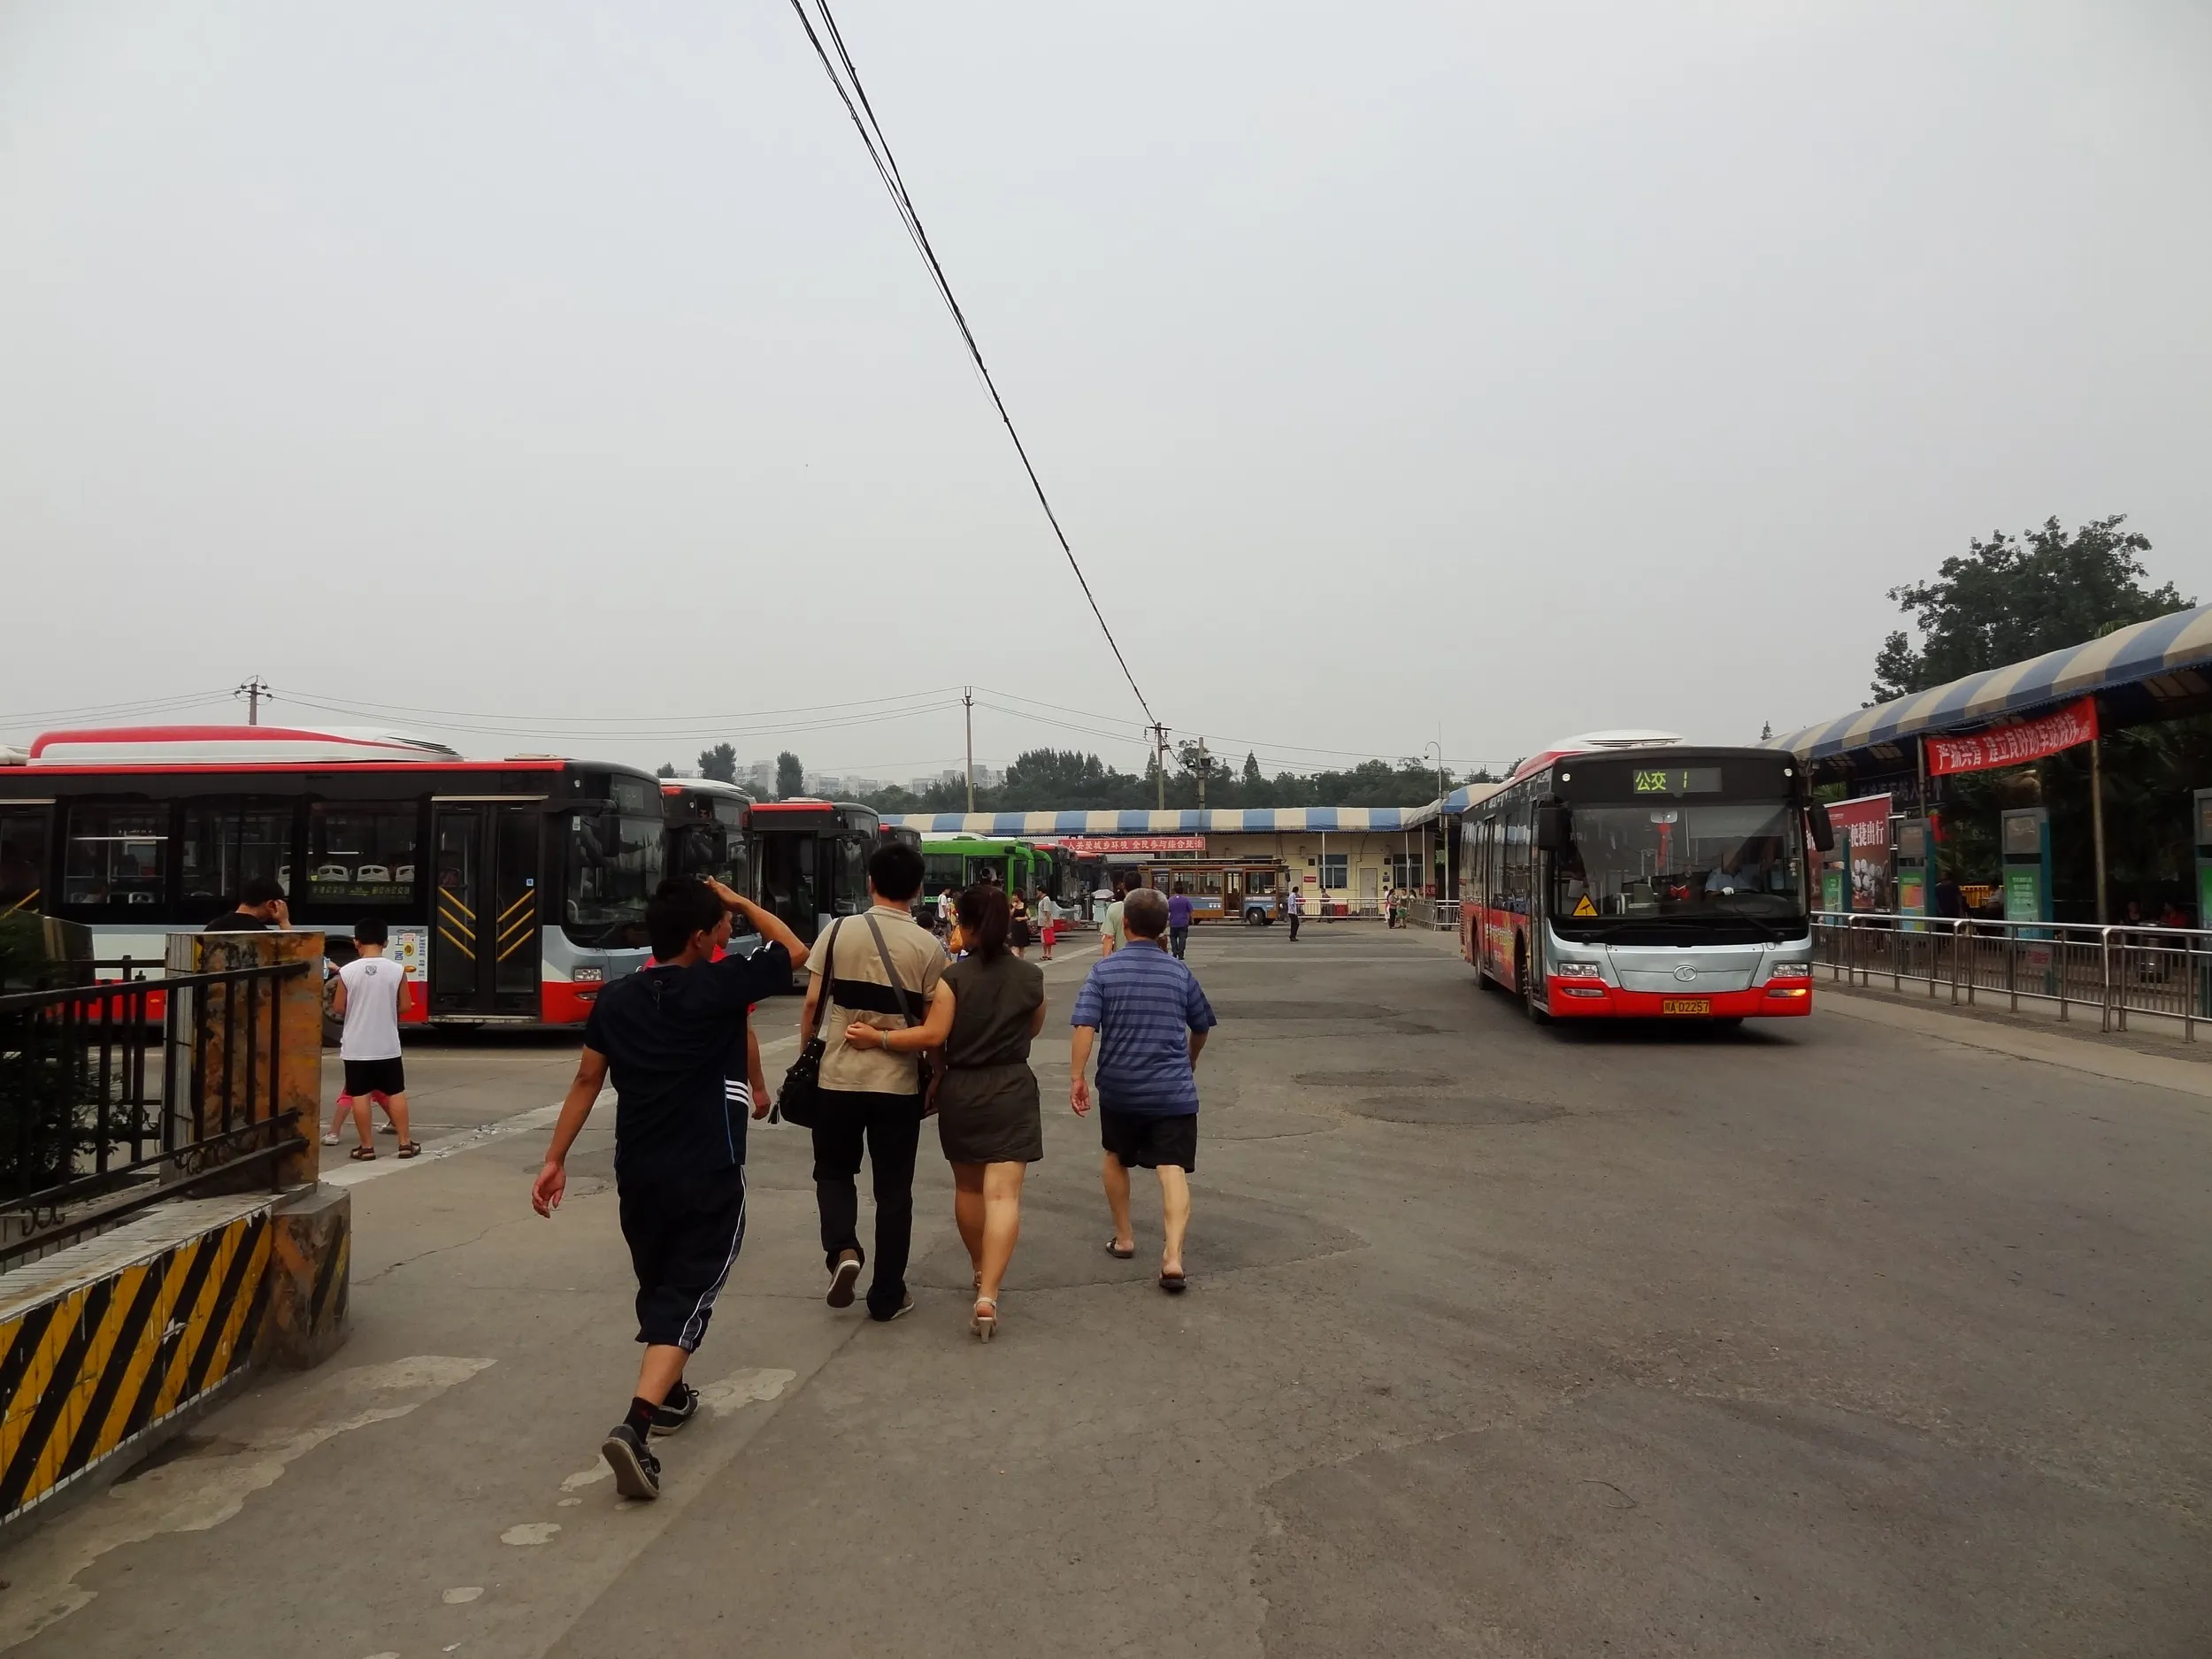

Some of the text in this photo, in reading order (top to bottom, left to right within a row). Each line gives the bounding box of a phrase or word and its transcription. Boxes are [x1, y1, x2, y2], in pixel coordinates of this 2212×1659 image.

[1635, 771, 1687, 790] 公交 1
[1850, 819, 1884, 848] 便捷出行
[1060, 839, 1203, 850] 人关爱城乡环境 全民参与综合整治
